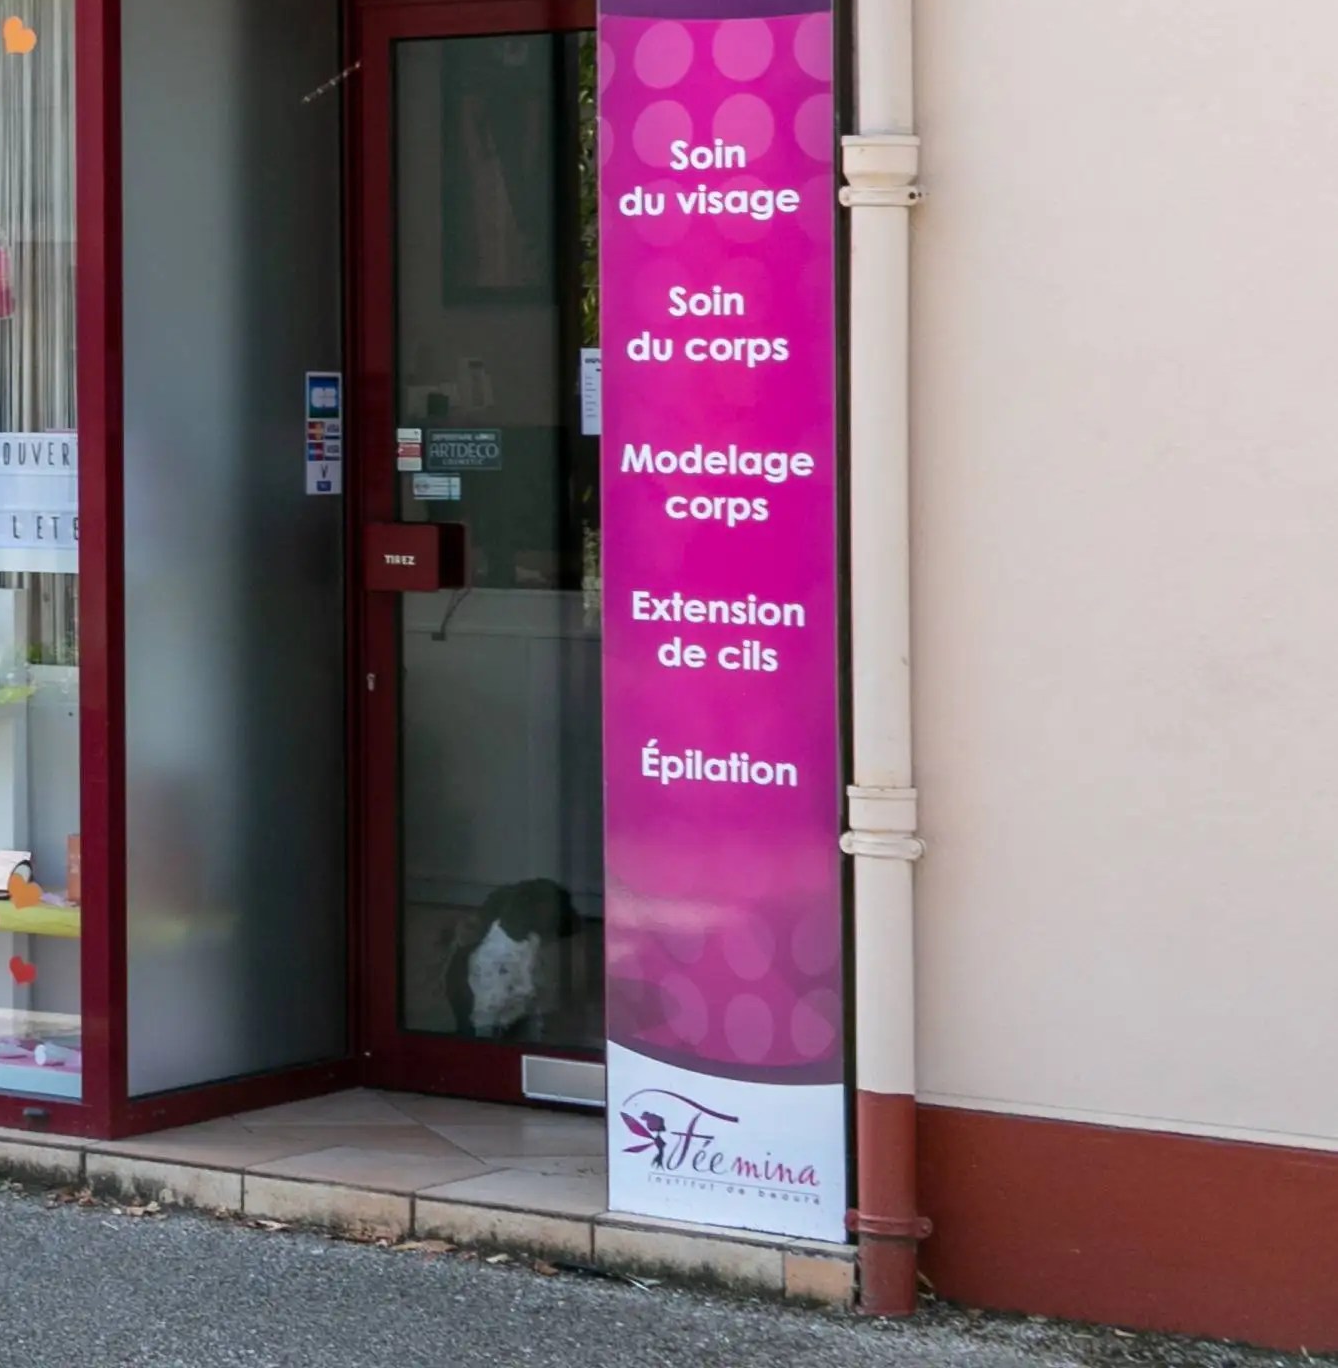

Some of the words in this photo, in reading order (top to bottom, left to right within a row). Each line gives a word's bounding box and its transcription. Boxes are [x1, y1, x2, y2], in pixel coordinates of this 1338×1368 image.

[669, 138, 746, 170] Soin
[619, 186, 665, 216] du
[676, 186, 800, 220] visage
[668, 285, 745, 317] Soin
[626, 332, 673, 362] du
[684, 336, 789, 368] corps
[430, 443, 499, 458] ARTDECO
[620, 443, 815, 483] Modelage
[665, 495, 769, 527] corps
[384, 554, 416, 565] TIREZ
[631, 590, 805, 627] Extension
[657, 636, 707, 668] de
[717, 639, 779, 672] cils
[641, 738, 798, 787] Épilation
[622, 1088, 820, 1187] Féemina
[647, 1174, 715, 1192] institut
[726, 1184, 746, 1196] de
